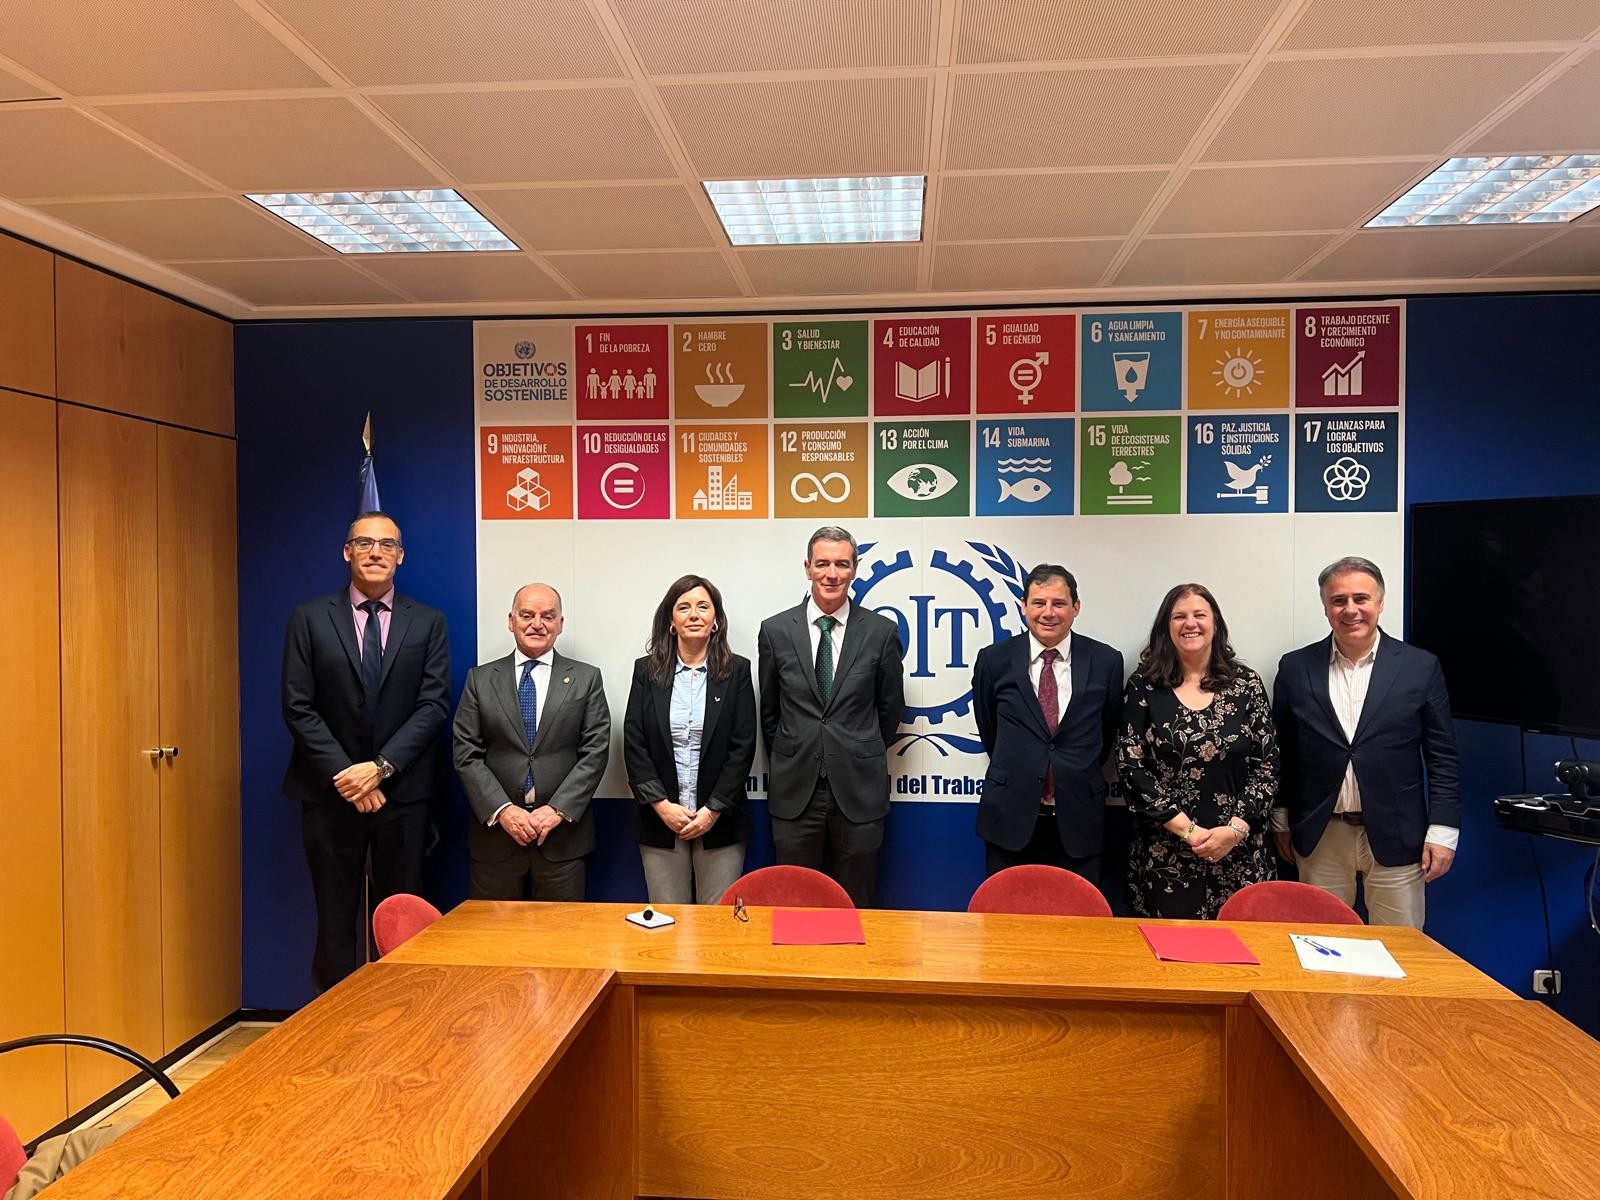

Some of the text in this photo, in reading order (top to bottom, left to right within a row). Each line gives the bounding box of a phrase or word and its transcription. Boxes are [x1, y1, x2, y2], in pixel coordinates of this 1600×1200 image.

[1108, 320, 1154, 330] AGUA LIMPIA
[1215, 317, 1285, 328] ENERGÍA ASEQUIBLE
[1321, 315, 1390, 325] TRABAJO DECENTE
[900, 325, 939, 336] EDUCACIÓN
[1003, 323, 1039, 333] IGUALDAD
[1199, 319, 1208, 340] 7
[1305, 316, 1316, 337] 8
[1321, 326, 1376, 336] Y CRECIMIENTO
[698, 331, 726, 341] HAMBRE
[798, 329, 820, 339] SALUD
[986, 324, 996, 345] 5
[1092, 322, 1102, 342] 6
[1108, 332, 1166, 342] Y SANEAMIENTO
[1215, 329, 1286, 339] Y NO CONTAMINANTE
[600, 333, 610, 342] FIN
[682, 332, 692, 352] 2
[782, 330, 792, 350] 3
[883, 328, 894, 347] 4
[900, 338, 939, 347] DE CALIDAD
[1003, 334, 1041, 344] DE GÉNERO
[1321, 336, 1365, 347] ECONÓMICO
[586, 333, 592, 353] 1
[699, 343, 716, 352] CERO
[798, 340, 840, 350] Y BIENESTAR
[600, 344, 650, 353] DE LA POBREZA
[483, 362, 567, 377] OBJETIVOS
[485, 378, 567, 388] DE DESARROLLO
[485, 389, 567, 401] SOSTENIBLE
[1112, 425, 1128, 434] VIDA
[1238, 423, 1271, 432] JUSTICIA
[1327, 420, 1385, 430] ALIANZAS PARA
[605, 431, 666, 442] REDUCCIÓN DE LAS
[802, 430, 846, 440] PRODUCCIÓN
[903, 428, 929, 438] ACCIÓN
[1008, 427, 1025, 436] VIDA
[1088, 425, 1106, 446] 15
[1195, 423, 1214, 444] 16
[1304, 421, 1321, 442] 17
[1327, 432, 1356, 441] LOGRAR
[699, 432, 738, 442] CIUDADES Y
[780, 431, 797, 452] 12
[880, 429, 897, 450] 13
[983, 428, 1000, 448] 14
[1112, 435, 1170, 445] DE ECOSISTEMAS
[1222, 434, 1279, 443] E INSTITUCIONES
[488, 434, 498, 454] 9
[502, 443, 547, 453] INNOVACIÓN E
[583, 433, 600, 454] 10
[681, 433, 695, 453] 11
[699, 443, 747, 452] COMUNIDADES
[802, 441, 841, 450] Y CONSUMO
[903, 440, 949, 449] POR EL CLIMA
[1008, 438, 1050, 448] SUBMARINA
[1327, 443, 1384, 453] LOS OBJETIVOS
[604, 444, 659, 453] DESIGUALDADES
[1112, 446, 1154, 456] TERRESTRES
[1221, 444, 1251, 455] SÓLIDAS
[502, 455, 565, 464] INFRAESTRUCTURA
[699, 453, 743, 463] SOSTENIBLES
[802, 452, 855, 462] RESPONSABLES
[896, 775, 927, 794] del
